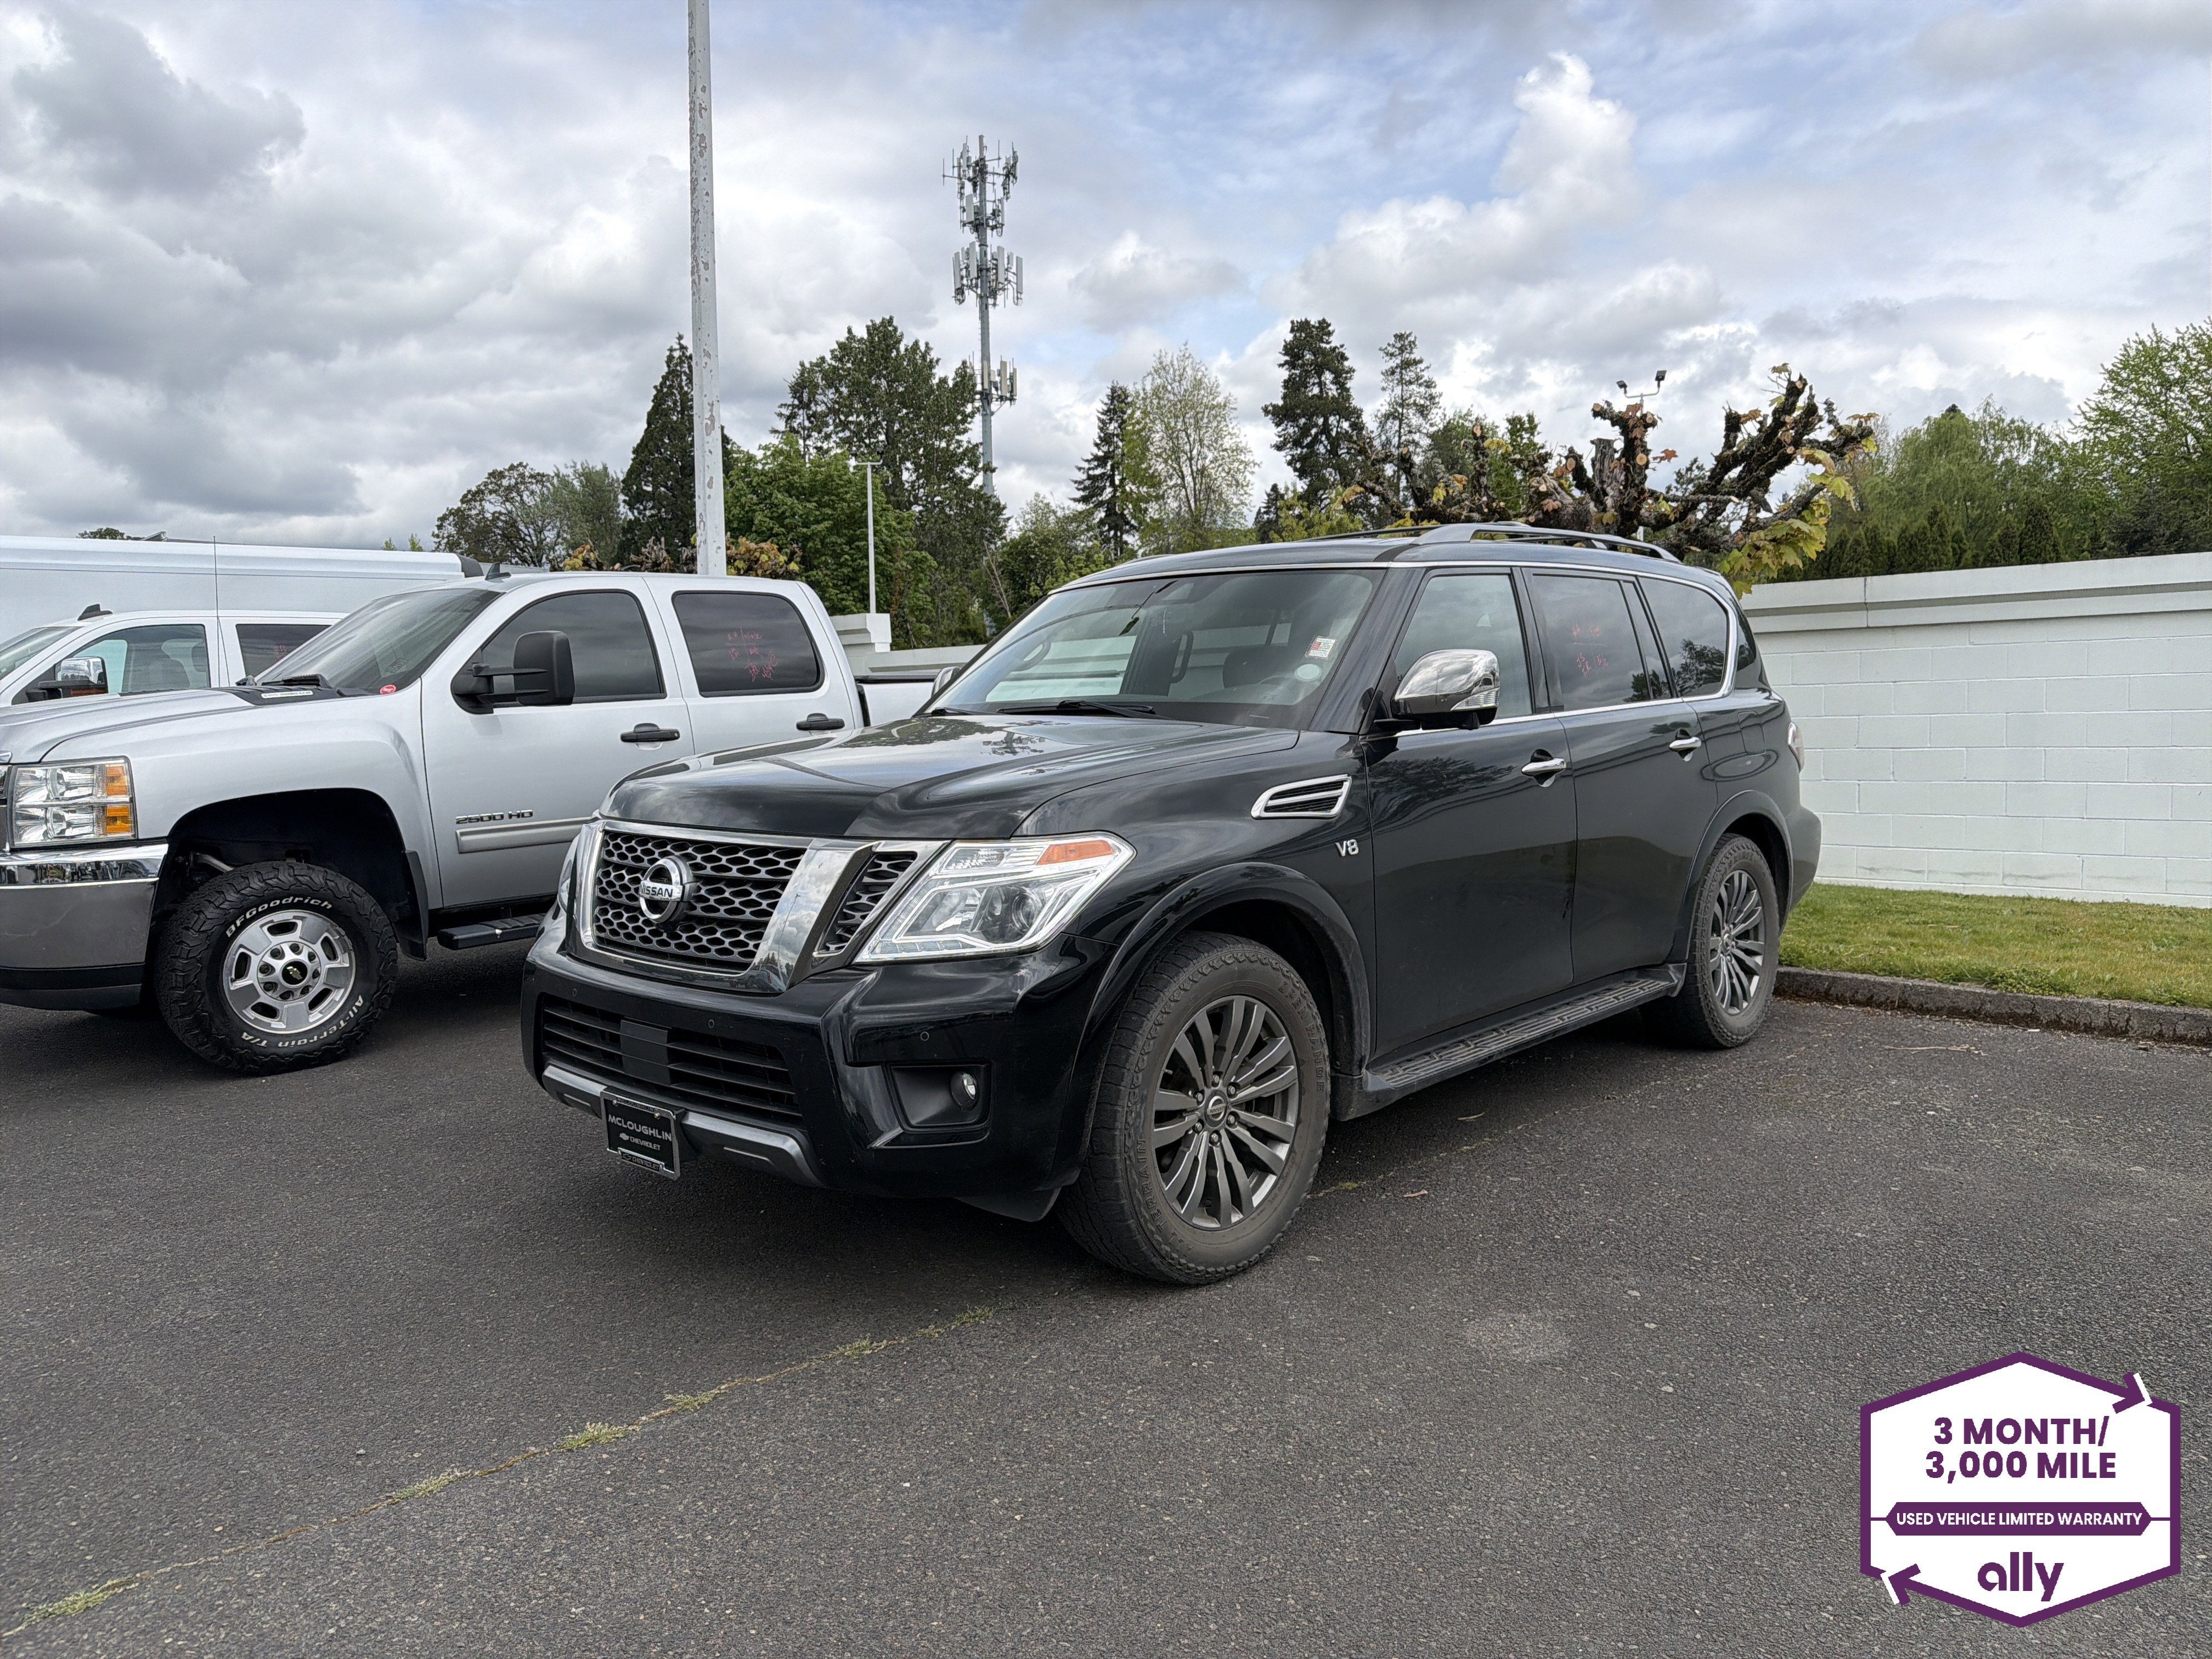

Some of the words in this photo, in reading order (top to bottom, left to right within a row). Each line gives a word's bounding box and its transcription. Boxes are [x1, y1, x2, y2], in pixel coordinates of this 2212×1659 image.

[455, 812, 504, 825] 2500
[508, 809, 533, 819] HD
[1335, 839, 1359, 857] V8
[639, 882, 673, 898] NISSAN
[225, 896, 332, 938] BFGoodrich
[278, 995, 364, 1048] All-Terrain
[241, 1032, 269, 1048] T/A
[1278, 981, 1307, 1019] OPEN
[1306, 1023, 1325, 1092] RANGE
[608, 1114, 673, 1142] MCLOUGHLIN
[629, 1136, 661, 1151] CHEVROLET
[1137, 1139, 1167, 1232] TERRAIN
